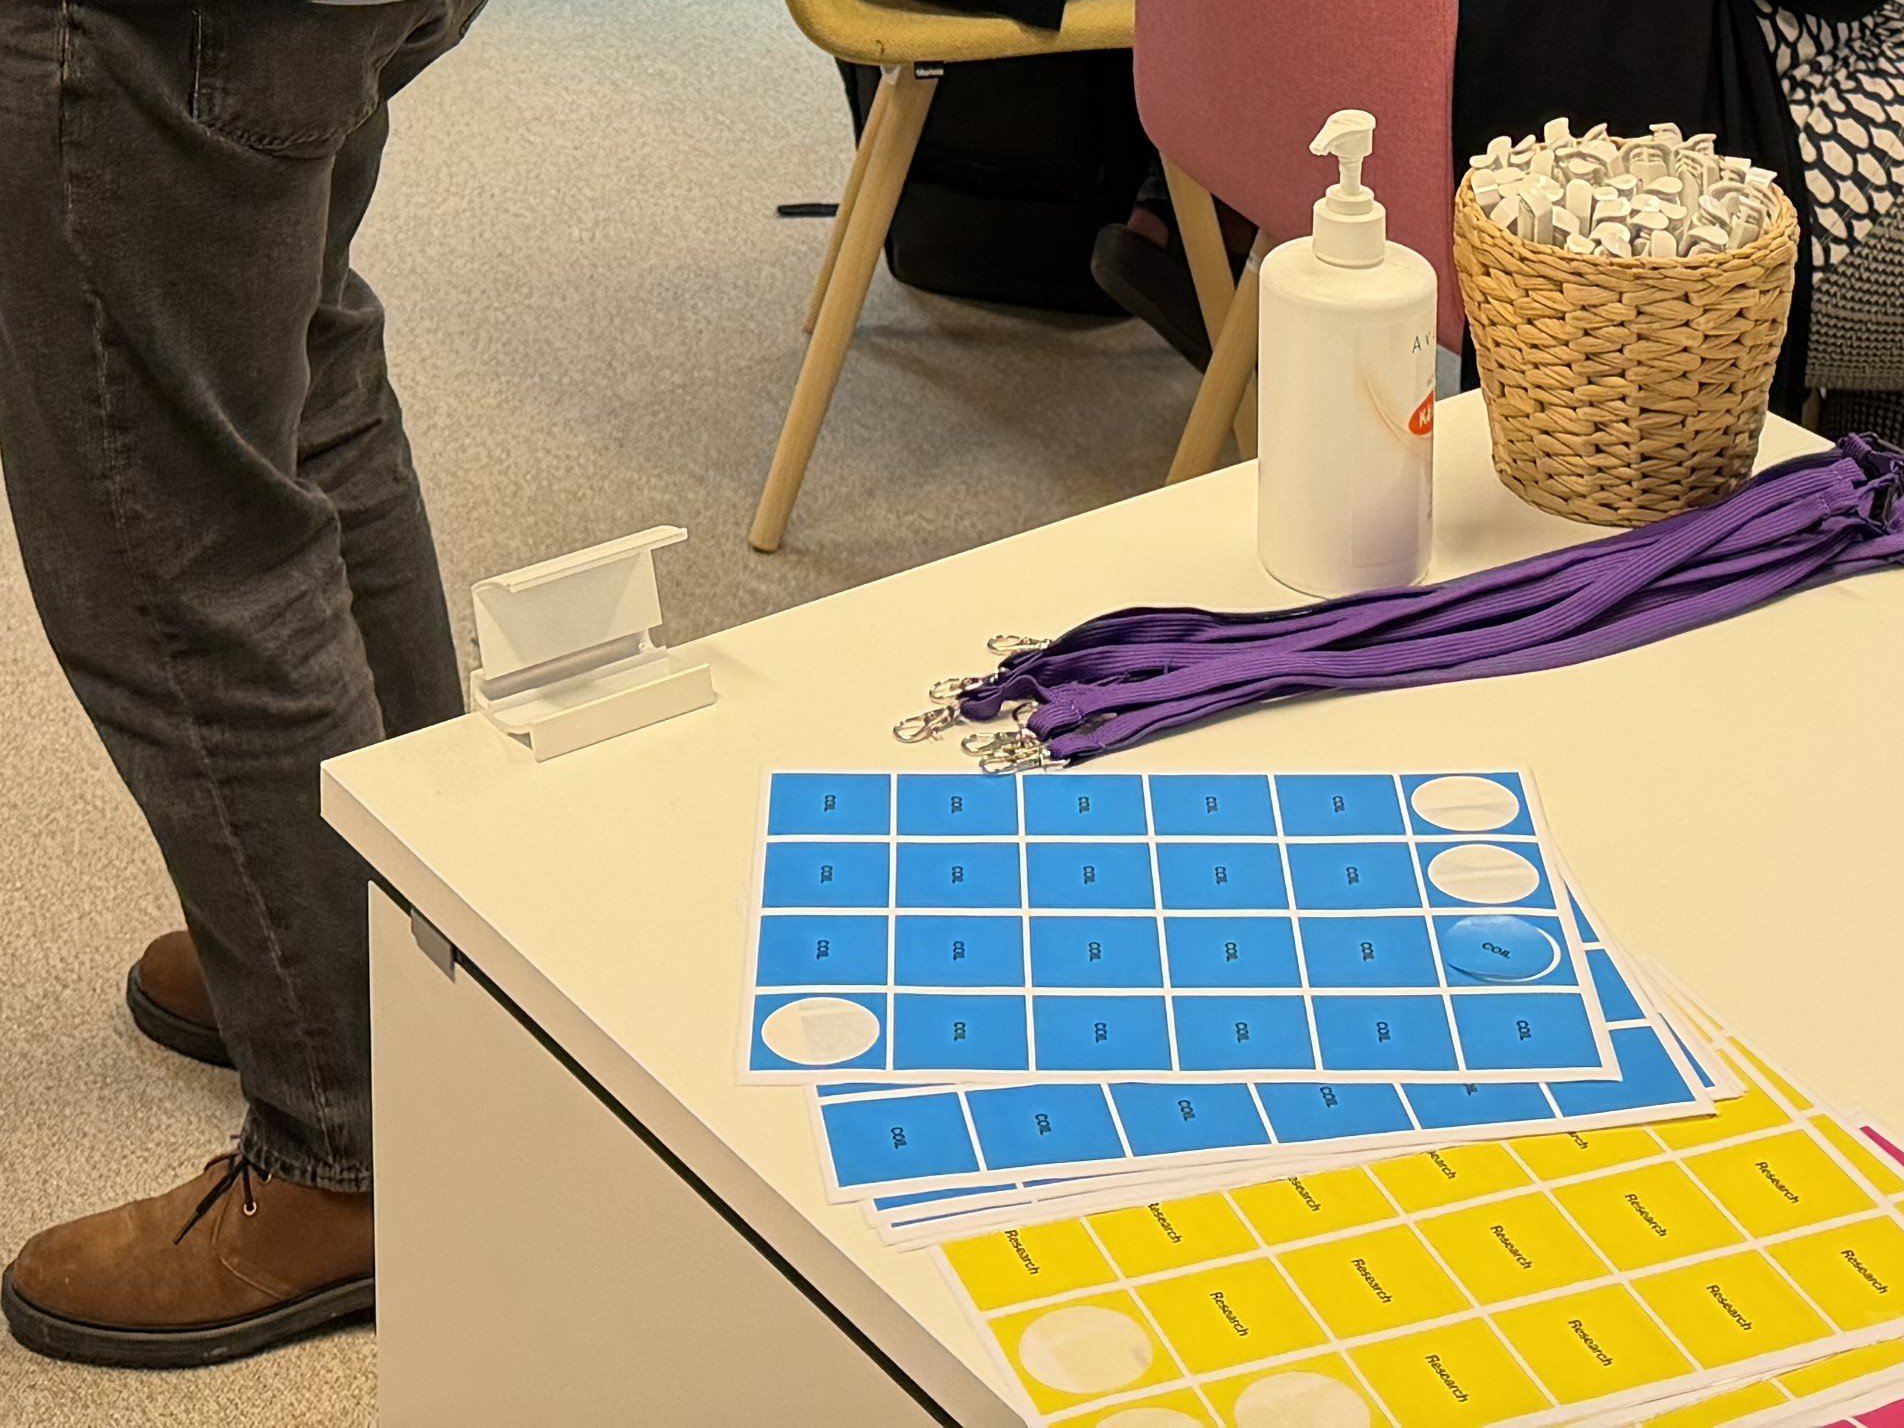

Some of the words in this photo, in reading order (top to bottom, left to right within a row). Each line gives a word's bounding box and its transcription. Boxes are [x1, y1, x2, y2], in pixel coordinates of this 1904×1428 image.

[823, 794, 837, 813] COIL
[950, 795, 963, 814] COIL
[1077, 796, 1090, 814] COIL
[1205, 796, 1218, 814] COIL
[1332, 795, 1345, 813] COIL
[820, 865, 834, 884] COIL
[951, 865, 964, 884] COIL
[1083, 865, 1096, 885] COIL
[1214, 866, 1228, 885] COIL
[1345, 866, 1360, 885] COIL
[816, 939, 830, 960] COIL
[952, 940, 965, 962] COIL
[1088, 941, 1102, 962] COIL
[1224, 941, 1238, 963] COIL
[1360, 941, 1375, 962] COIL
[953, 1021, 966, 1042] COIL
[1094, 1022, 1108, 1044] COIL
[1234, 1021, 1250, 1043] COIL
[1376, 1021, 1391, 1043] COIL
[1515, 1020, 1532, 1041] COIL
[1320, 1086, 1338, 1108] COIL
[1177, 1099, 1196, 1122] COIL
[1034, 1113, 1052, 1136] COIL
[890, 1126, 907, 1150] COIL
[1754, 1161, 1800, 1204] Research
[1624, 1193, 1667, 1238] Research
[1004, 1229, 1040, 1275] Research
[1489, 1224, 1533, 1270] Research
[1350, 1258, 1393, 1304] Research
[1840, 1249, 1888, 1294] Research
[1209, 1291, 1249, 1337] Research
[1706, 1284, 1752, 1331] Research
[1567, 1319, 1613, 1367] Research
[1424, 1354, 1470, 1403] Research
